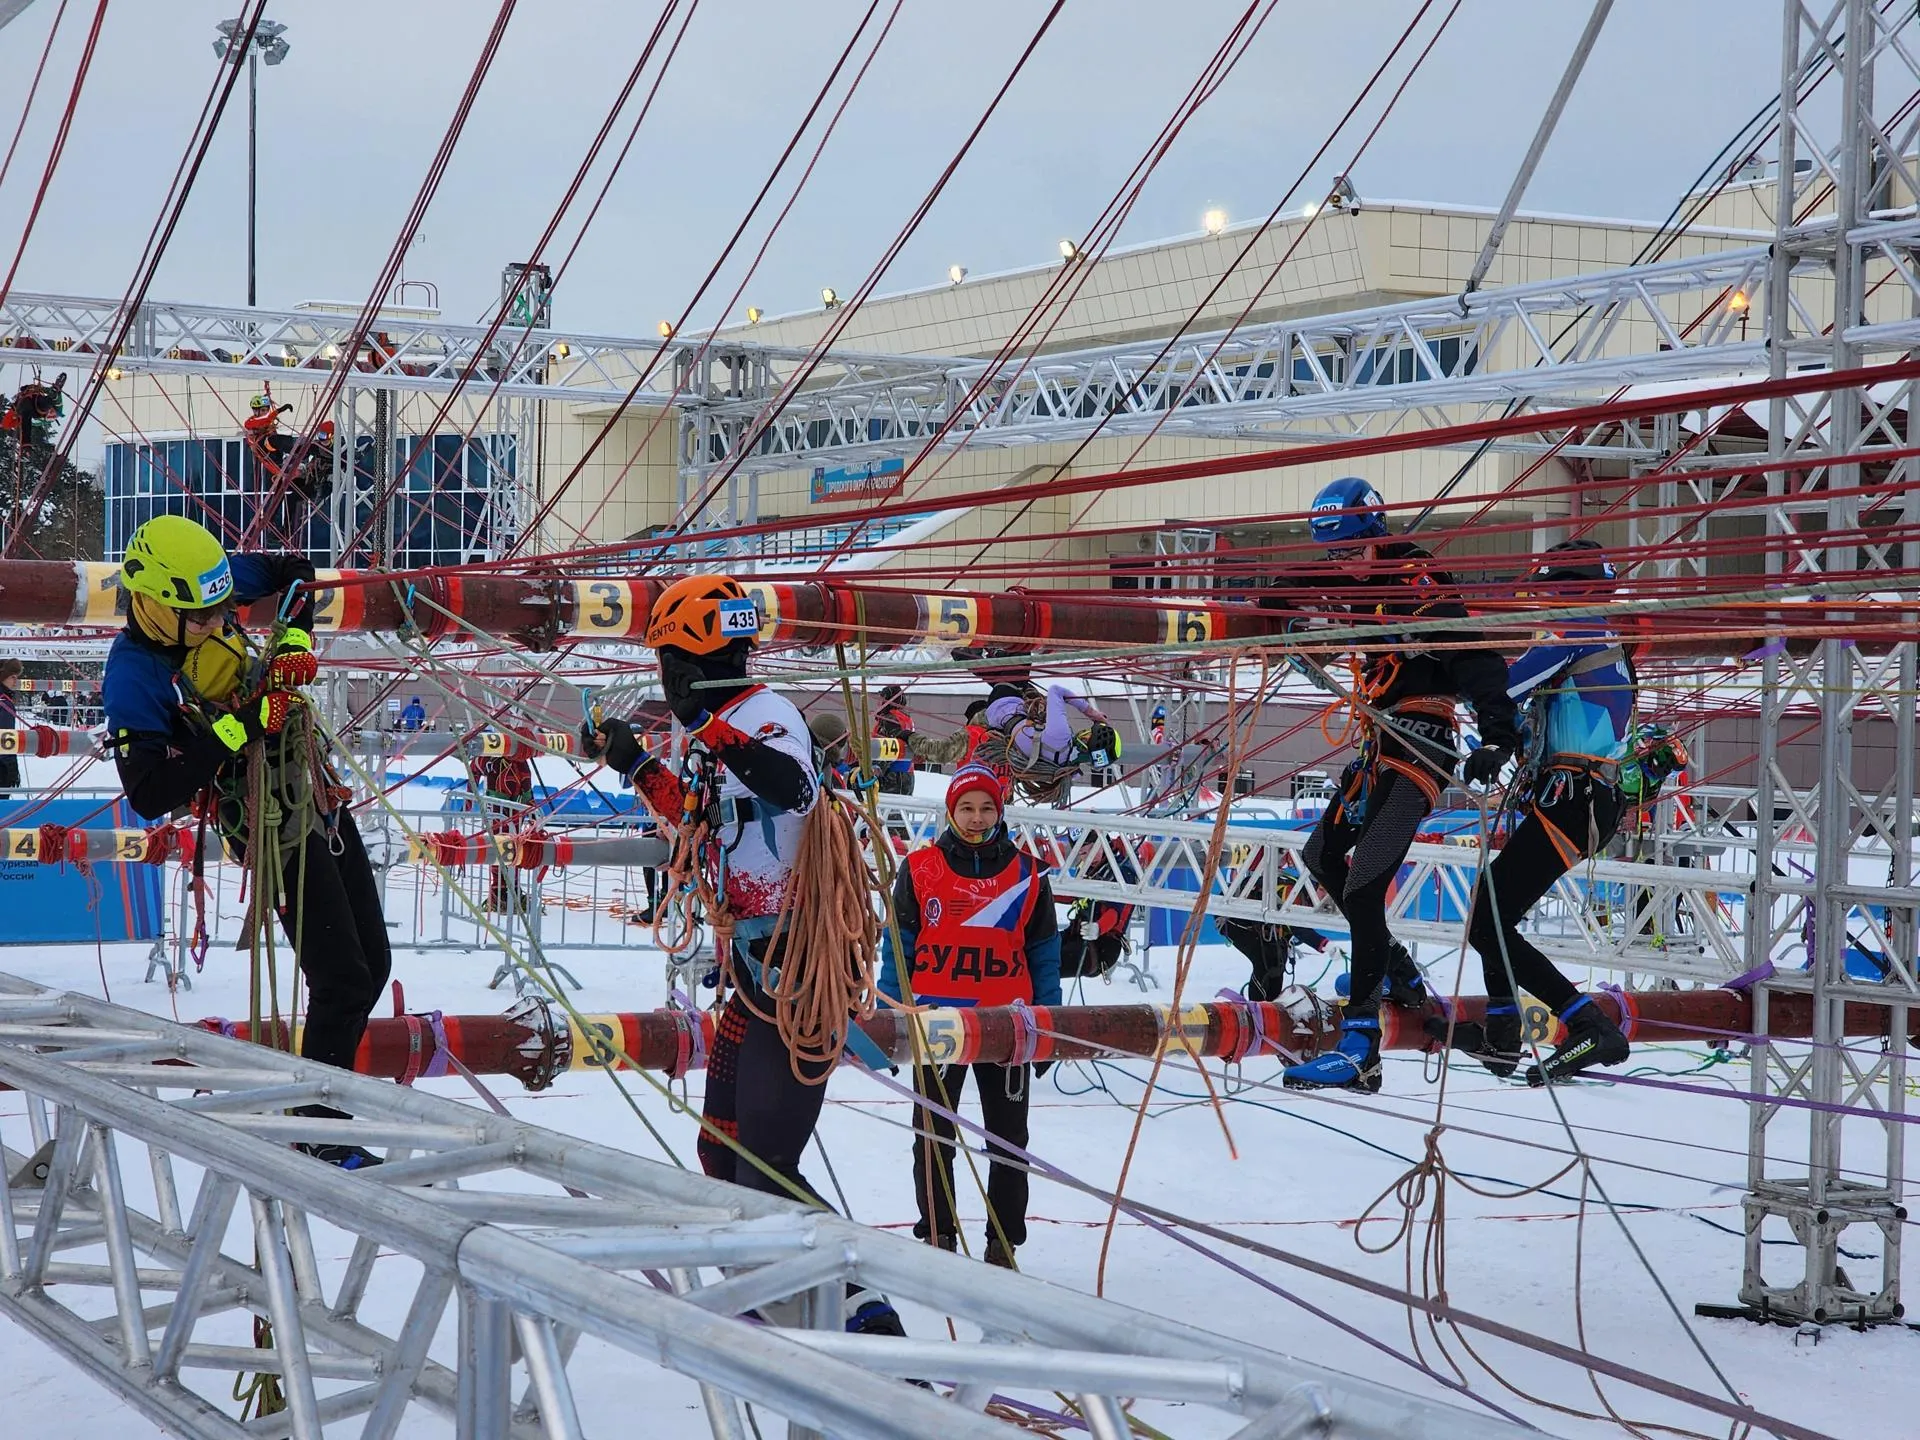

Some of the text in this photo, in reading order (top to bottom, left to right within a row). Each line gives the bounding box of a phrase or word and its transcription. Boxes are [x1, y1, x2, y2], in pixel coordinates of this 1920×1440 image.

[56, 341, 67, 351] 10
[167, 350, 178, 359] 12
[285, 358, 297, 368] 14
[101, 570, 129, 616] 1
[209, 571, 230, 594] 426
[589, 582, 624, 628] 3
[728, 611, 755, 629] 435
[939, 599, 970, 641] 5
[1177, 609, 1206, 644] 6
[649, 621, 676, 644] VENTO
[22, 681, 32, 690] 15
[0, 731, 16, 751] 6
[488, 734, 501, 749] 9
[549, 735, 564, 752] 10
[882, 739, 899, 756] 14
[15, 833, 36, 857] 4
[123, 836, 142, 859] 5
[501, 841, 516, 862] 8
[1525, 1005, 1550, 1041] 8
[583, 1023, 616, 1066] 3
[927, 1019, 956, 1062] 5
